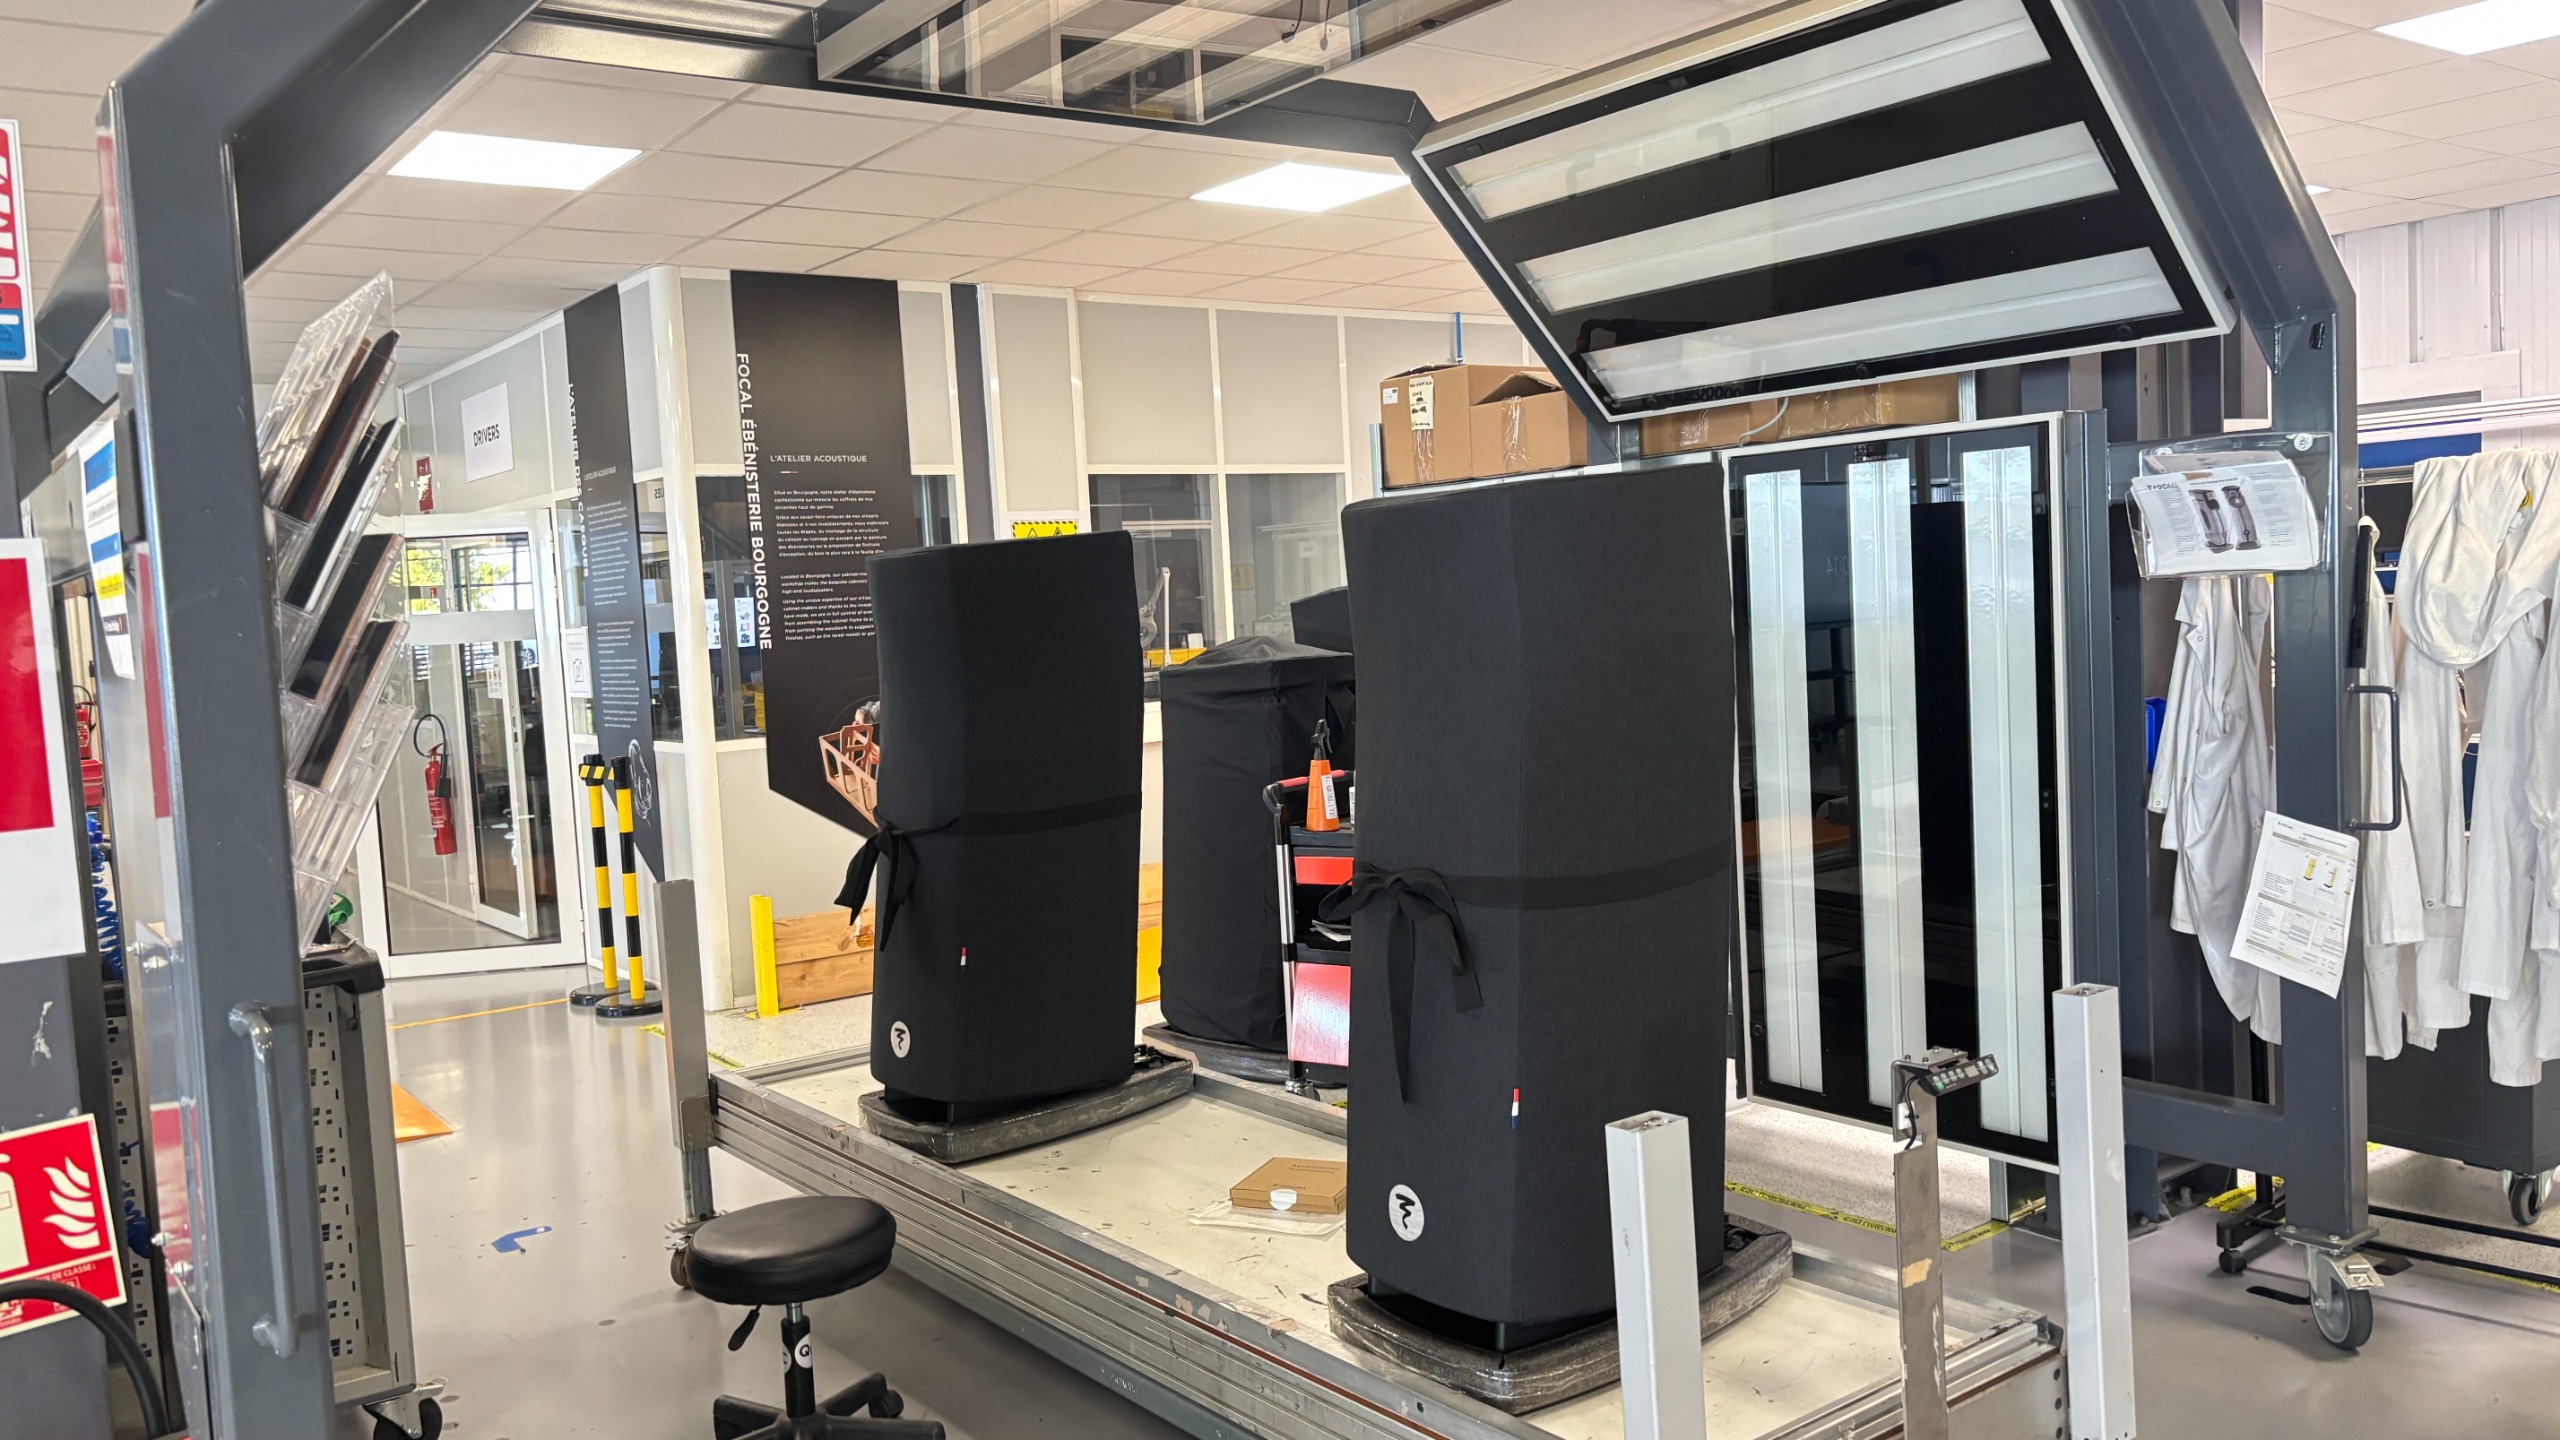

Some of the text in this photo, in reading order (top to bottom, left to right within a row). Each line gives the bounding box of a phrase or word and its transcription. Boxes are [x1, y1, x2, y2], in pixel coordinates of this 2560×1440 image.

[473, 423, 501, 447] DRIVERS
[770, 454, 867, 464] L'ATELIER ACOUSTIQUE
[568, 383, 589, 577] L'ATELIER DES CASQUES
[736, 353, 772, 650] FOCAL ÉBÉNISTERIE BOURGOGNE
[51, 1271, 63, 1280] DE
[63, 1264, 92, 1277] CLASSE
